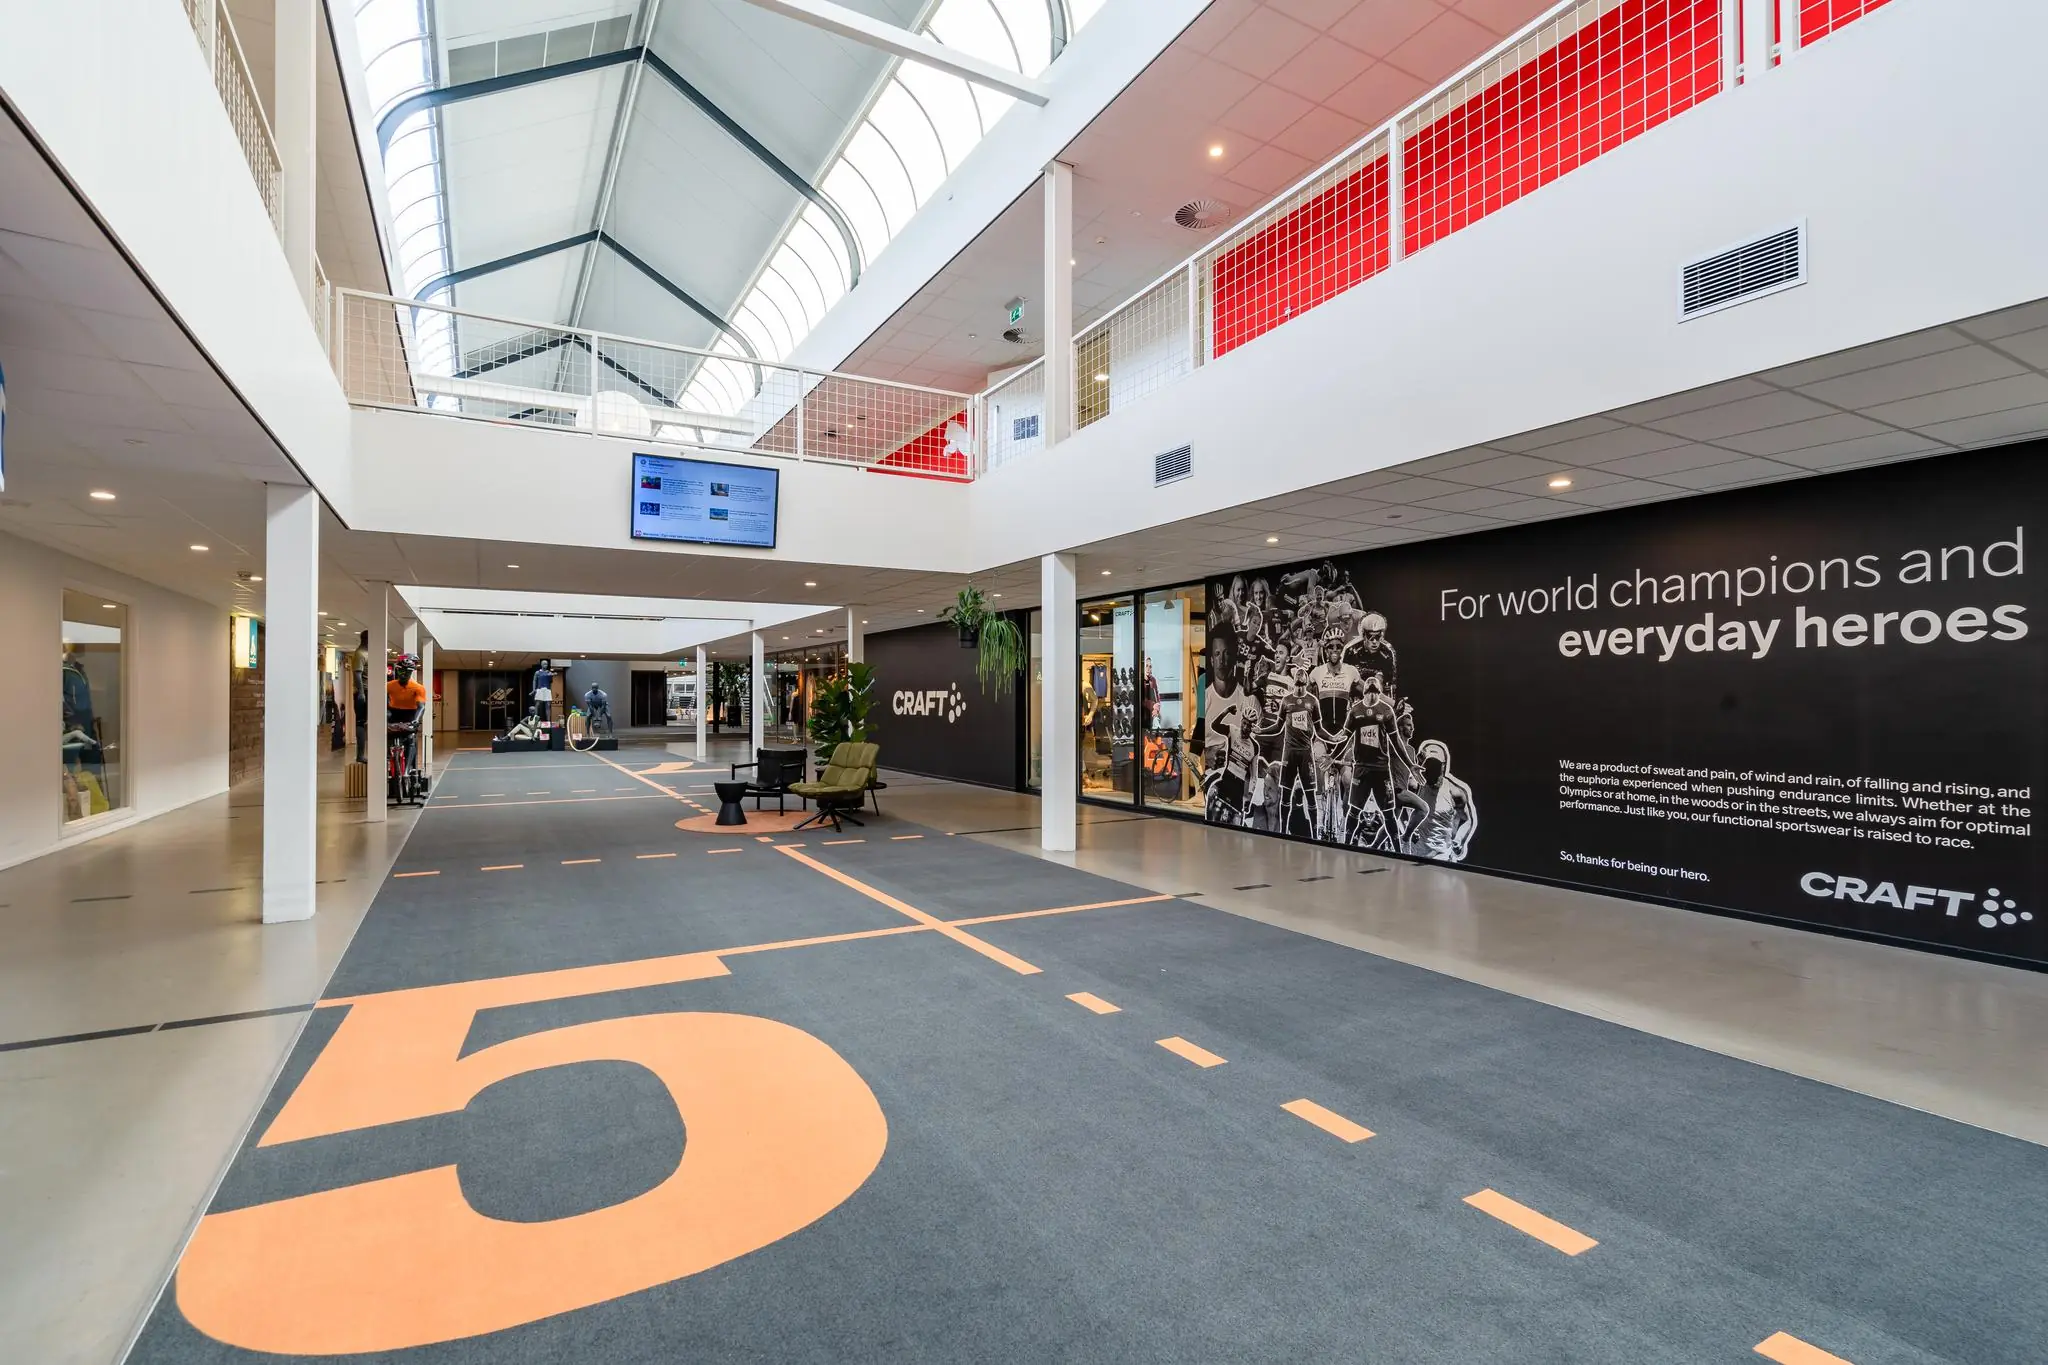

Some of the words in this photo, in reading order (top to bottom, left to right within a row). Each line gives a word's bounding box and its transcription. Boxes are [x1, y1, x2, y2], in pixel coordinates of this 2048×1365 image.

[1441, 588, 1491, 621] For
[1497, 573, 1598, 616] world
[1609, 555, 1881, 607] champions
[1898, 526, 2024, 584] and
[1558, 612, 1781, 662] everyday
[1795, 604, 2029, 648] heroes
[892, 690, 949, 716] CRAFT
[1294, 714, 1307, 723] vdk
[1361, 729, 1377, 738] vdk
[1559, 760, 1575, 769] We
[1576, 762, 1591, 770] are
[1592, 763, 1598, 771] a
[1600, 763, 1639, 773] product
[1640, 764, 1652, 774] of
[1653, 767, 1685, 776] sweat
[1686, 768, 1708, 778] and
[1710, 769, 1738, 781] pain,
[1740, 770, 1754, 781] of
[1754, 771, 1785, 783] wind
[1788, 774, 1812, 785] and
[1815, 775, 1844, 788] rain,
[1846, 776, 1862, 788] of
[1864, 777, 1909, 793] falling
[1912, 781, 1942, 793] and
[1945, 782, 1994, 799] rising,
[1997, 787, 2030, 799] and
[1559, 773, 1575, 782] the
[1577, 775, 1620, 786] euphoria
[1622, 779, 1687, 791] experienced
[1691, 782, 1723, 794] when
[1727, 786, 1775, 800] pushing
[1779, 789, 1851, 804] endurance
[1856, 793, 1897, 807] limits.
[1902, 796, 1973, 813] Whether
[1978, 803, 1995, 815] at
[2001, 804, 2031, 817] the
[1559, 785, 1602, 798] Olympics
[1615, 791, 1625, 800] at
[1627, 791, 1658, 804] home,
[1659, 794, 1669, 804] in
[1671, 795, 1689, 806] the
[1691, 798, 1729, 809] woods
[1731, 802, 1744, 810] or
[1746, 801, 1757, 811] in
[1759, 802, 1780, 814] the
[1782, 805, 1830, 819] streets,
[1832, 810, 1853, 820] we
[1856, 810, 1906, 826] always
[1908, 815, 1936, 828] aim
[1939, 817, 1964, 830] for
[1966, 821, 2030, 836] optimal
[1560, 800, 1622, 813] performance.
[1623, 805, 1645, 816] Just
[1647, 806, 1665, 818] like
[1666, 811, 1690, 821] you,
[1691, 813, 1711, 822] our
[1712, 813, 1773, 828] functional
[1775, 821, 1851, 836] sportswear
[1853, 826, 1864, 838] is
[1867, 829, 1912, 843] raised
[1915, 833, 1932, 845] to
[1935, 837, 1974, 849] race.
[1560, 850, 1575, 863] So,
[1576, 853, 1609, 867] thanks
[1611, 858, 1626, 869] for
[1627, 860, 1658, 876] being
[1659, 867, 1679, 877] our
[1680, 868, 1710, 882] hero.
[1800, 872, 1976, 917] CRAFT
[175, 955, 889, 1356] 5
